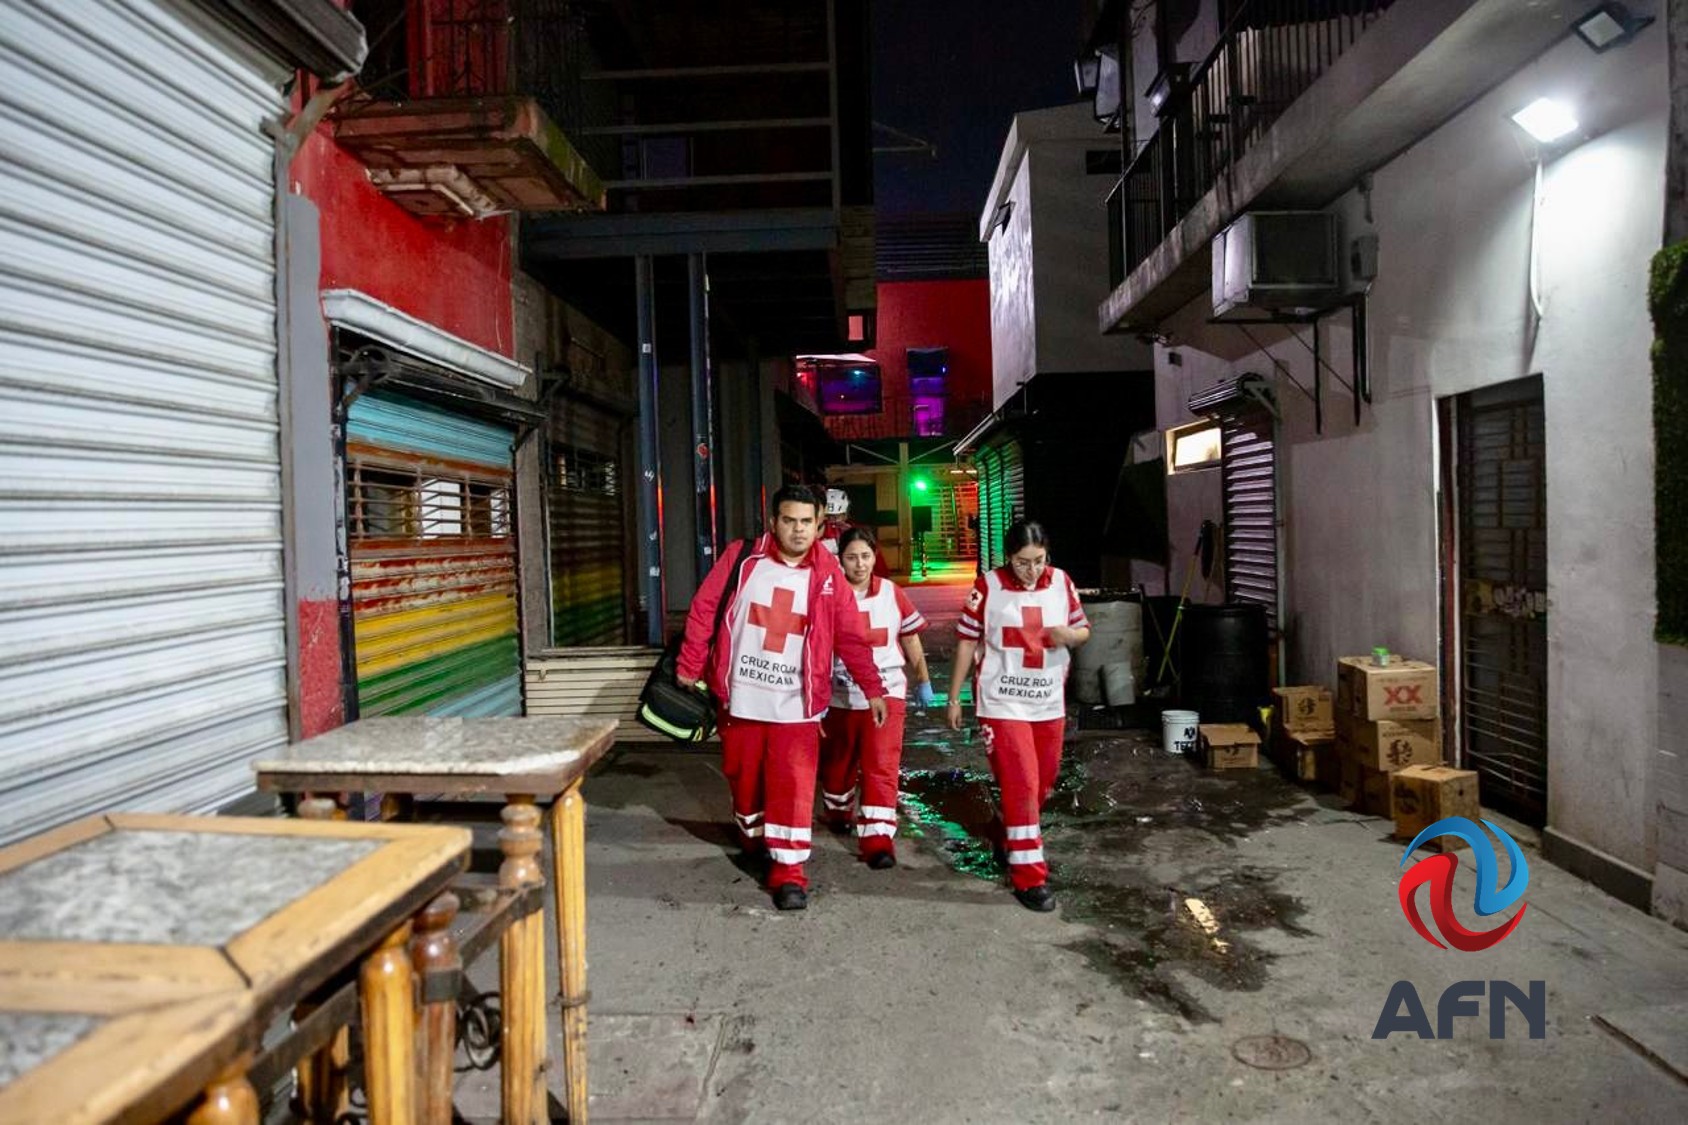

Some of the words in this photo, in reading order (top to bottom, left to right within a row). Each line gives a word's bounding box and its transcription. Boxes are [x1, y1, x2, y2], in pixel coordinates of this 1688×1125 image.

[740, 654, 770, 670] CRUZ
[1000, 674, 1031, 687] CRUZ
[1382, 685, 1423, 706] XX
